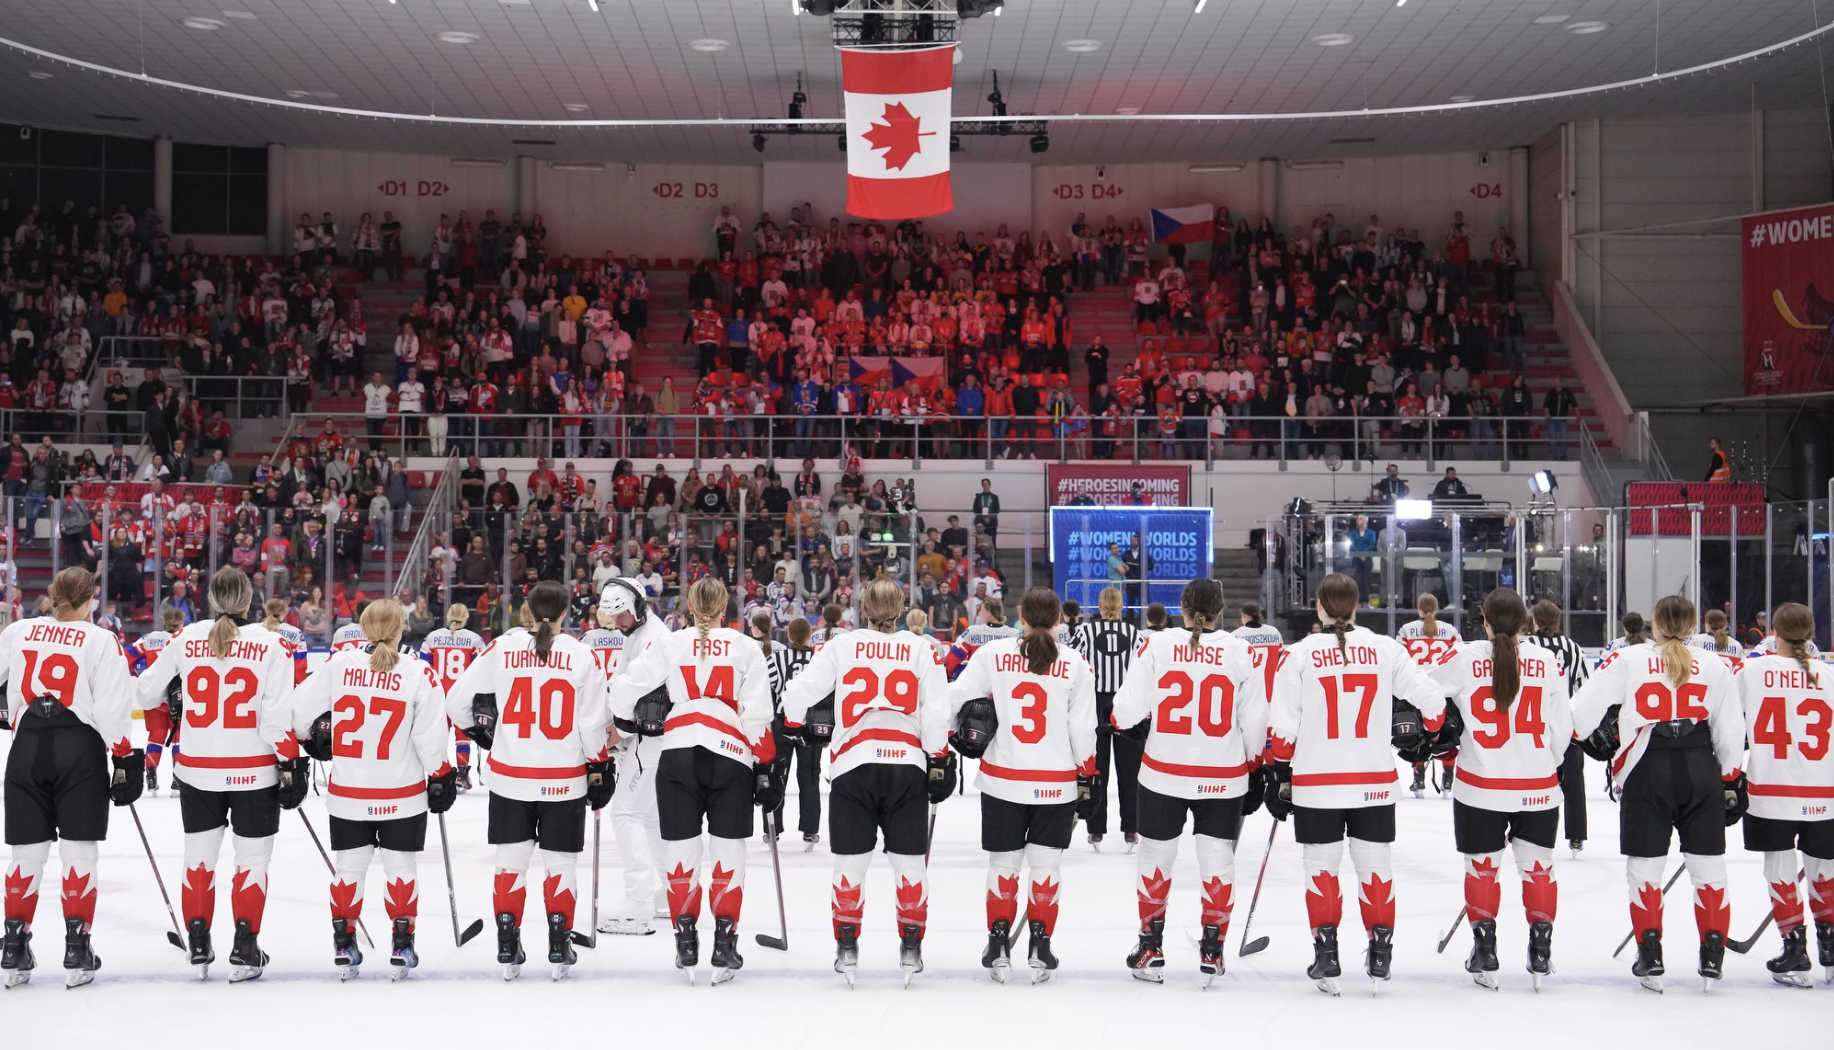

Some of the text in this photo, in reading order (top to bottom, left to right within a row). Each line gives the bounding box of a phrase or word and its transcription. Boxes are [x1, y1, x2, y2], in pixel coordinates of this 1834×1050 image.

[385, 181, 443, 197] D1 D2
[659, 183, 719, 198] D2 D3
[1060, 183, 1117, 199] D3 D4
[1477, 183, 1502, 199] D4
[1750, 215, 1834, 248] #WOME
[25, 624, 86, 648] JENNER
[1106, 633, 1117, 652] 11
[185, 639, 269, 662] SERCHNY
[693, 638, 731, 657] FAST
[855, 641, 911, 662] POULIN
[1173, 644, 1224, 666] NURSE
[1311, 645, 1378, 668] SHETON
[436, 648, 466, 680] 18
[1472, 657, 1546, 679] GANER
[21, 650, 79, 707] 19
[343, 668, 402, 692] MALTAIS
[1764, 670, 1824, 691] O'NEILL
[186, 665, 259, 729] 92
[680, 665, 739, 715] 14
[842, 667, 919, 728] 29
[502, 676, 576, 740] 40
[1011, 681, 1048, 744] 3
[1156, 670, 1236, 738] 20
[1318, 673, 1378, 740] 17
[320, 721, 330, 730] 27
[332, 694, 407, 760] 27
[1470, 686, 1546, 749] 94
[817, 726, 828, 734] 29
[971, 731, 977, 740] 3
[1400, 724, 1411, 734] 17
[1753, 697, 1834, 761] 43
[726, 740, 745, 757] IIHF
[882, 748, 907, 759] IIHF
[233, 775, 257, 785] IIHF
[1204, 784, 1228, 794] IIHF
[548, 786, 570, 796] IIHF
[1040, 788, 1063, 799] IIHF
[1370, 790, 1391, 801] IIHF
[1528, 795, 1551, 806] IIHF
[374, 805, 398, 816] IIHF
[1808, 805, 1828, 816] IIHF
[1136, 950, 1151, 968] CCM
